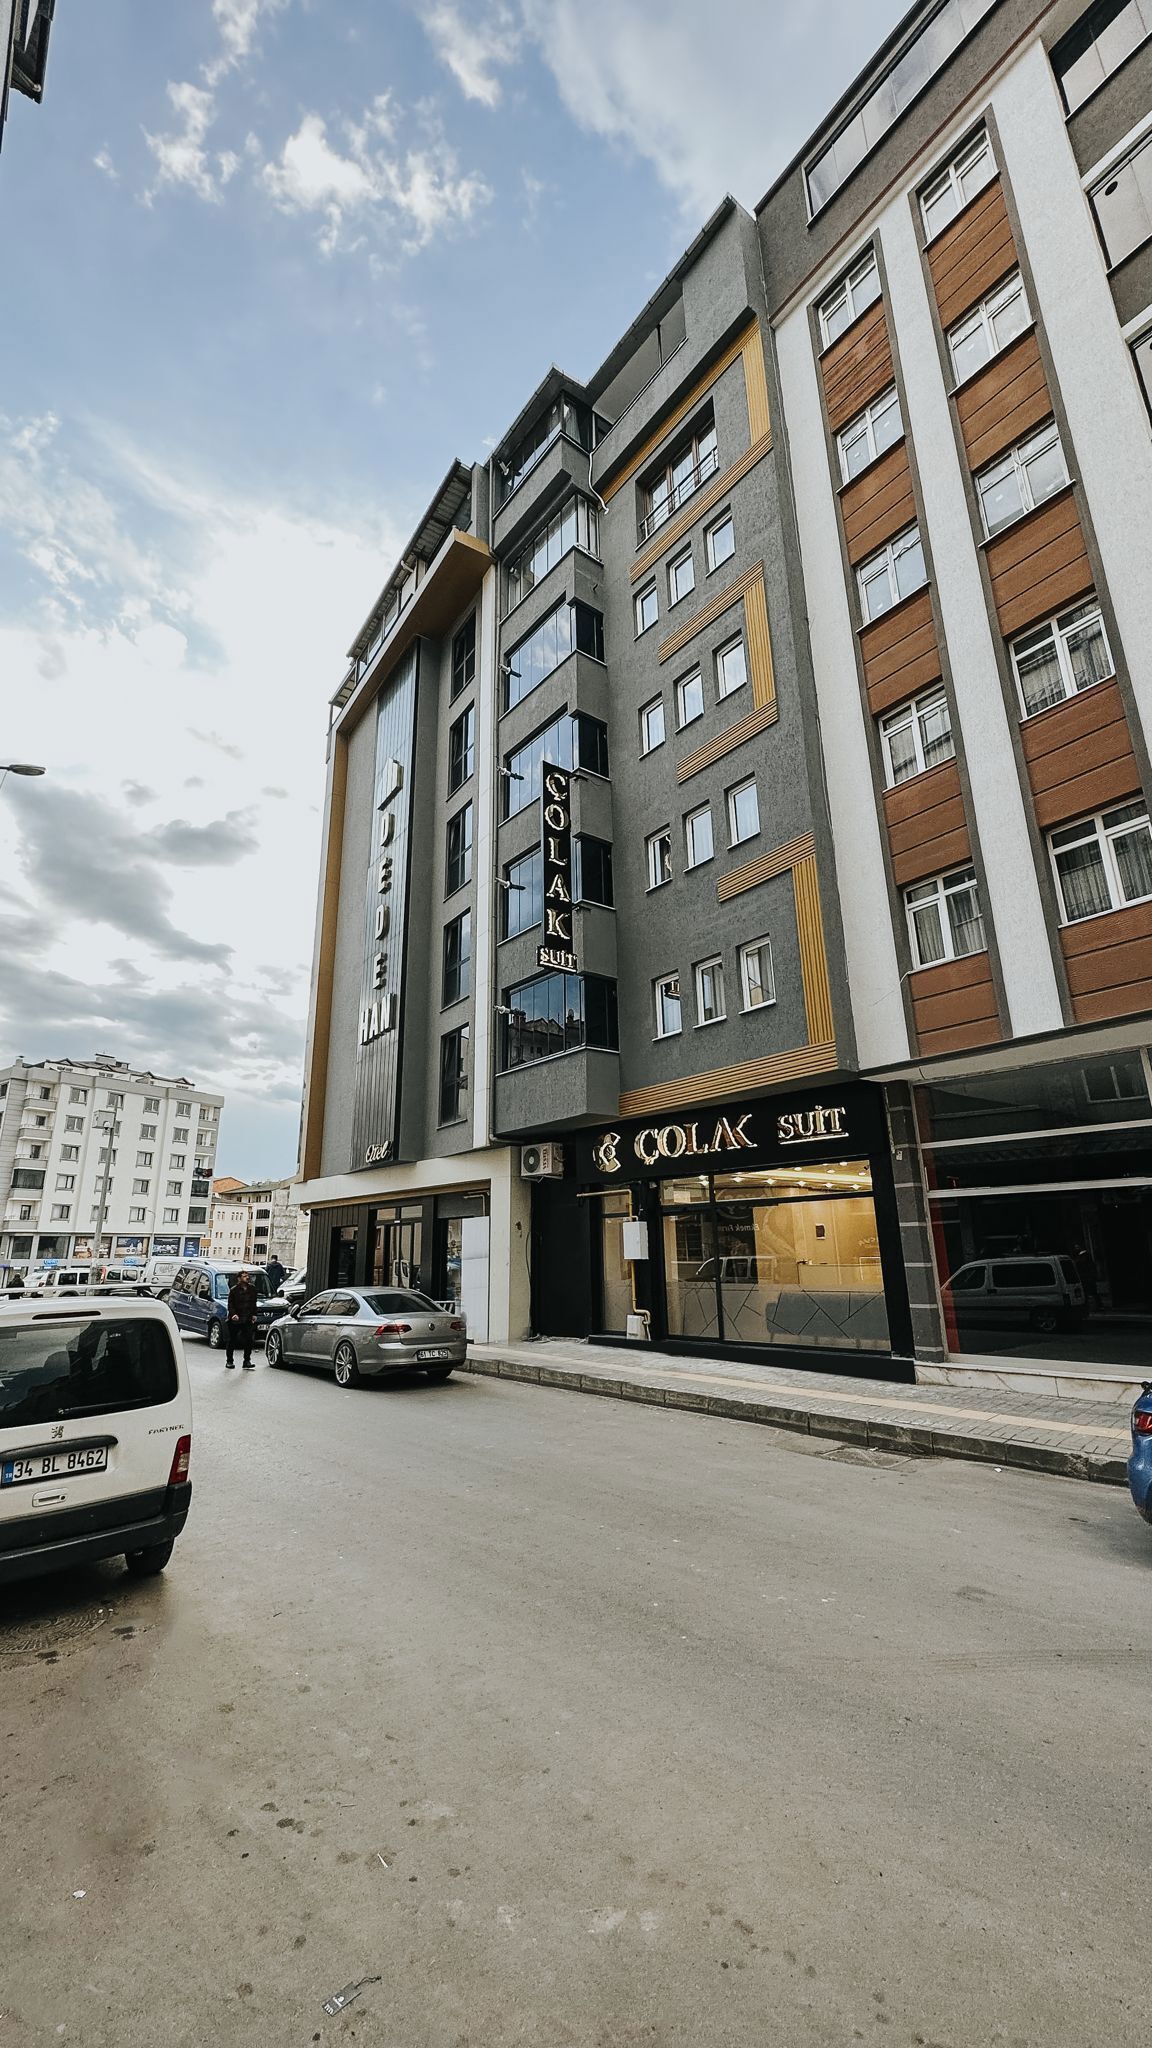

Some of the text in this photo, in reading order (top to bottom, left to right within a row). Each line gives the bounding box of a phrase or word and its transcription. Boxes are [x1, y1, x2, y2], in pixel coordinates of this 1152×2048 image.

[544, 772, 571, 940] ÇOLAK
[373, 812, 396, 991] DEDE
[360, 993, 397, 1046] HAN
[634, 1105, 846, 1165] ÇOLAK SUİT
[14, 1460, 33, 1478] 34
[42, 1456, 60, 1474] BL
[67, 1449, 104, 1469] 8462
